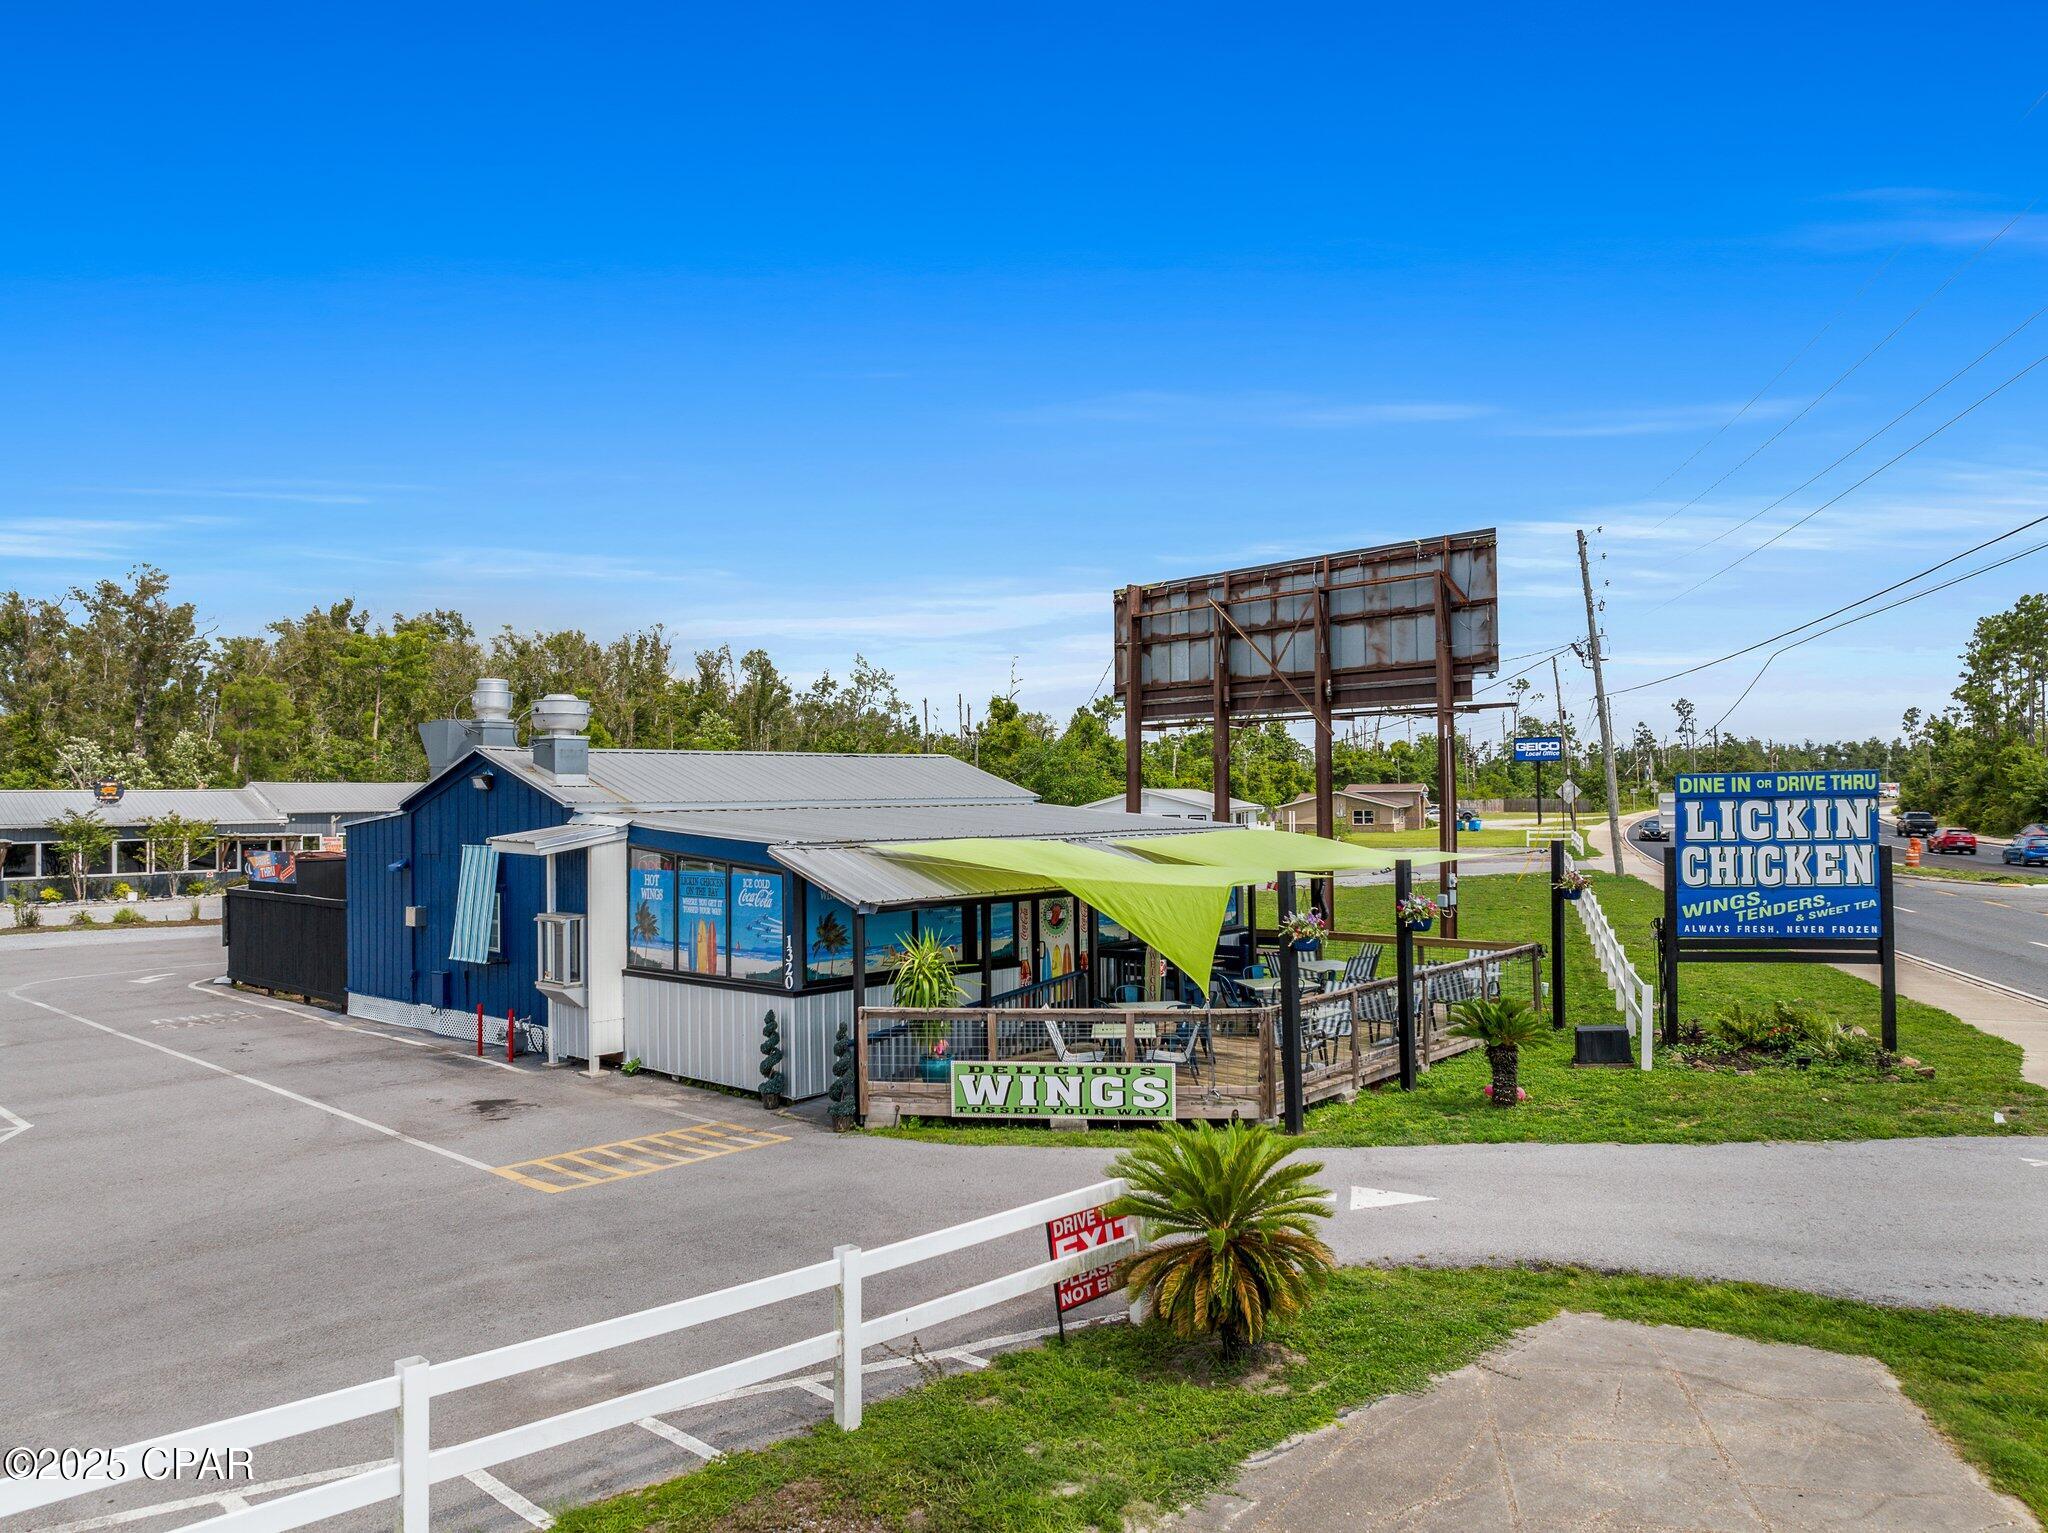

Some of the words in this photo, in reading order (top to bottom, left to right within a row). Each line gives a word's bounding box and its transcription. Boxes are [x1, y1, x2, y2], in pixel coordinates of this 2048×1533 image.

[1516, 742, 1560, 751] GEICO
[1680, 778, 1725, 793] DINE
[1732, 777, 1750, 793] IN
[1757, 780, 1771, 788] OR
[1777, 775, 1826, 792] DRIVE
[1830, 774, 1876, 790] THRU
[1684, 798, 1878, 841] LICKIN'
[260, 865, 276, 878] THRU
[1682, 845, 1875, 887] CHICKEN
[644, 874, 660, 886] HOT
[742, 878, 753, 888] ICE
[754, 878, 770, 889] COLD
[640, 888, 664, 900] WINGS
[1682, 891, 1768, 918] WINGS,
[1735, 894, 1831, 922] TENDERS,
[1796, 914, 1804, 922] &
[1808, 905, 1850, 920] SWEET
[1854, 899, 1876, 909] TEA
[1684, 925, 1730, 933] ALWAYS
[1787, 925, 1824, 933] NEVER
[1832, 925, 1878, 933] FROZEN
[784, 935, 794, 989] 1320
[968, 1065, 1156, 1075] DELICIOUS
[958, 1074, 1168, 1108] WINGS
[956, 1106, 1039, 1114] TOSSED
[1051, 1107, 1105, 1115] YOUR
[1116, 1108, 1171, 1116] WAY!
[1053, 1209, 1096, 1238] DRIVE
[1062, 1283, 1093, 1306] NOT
